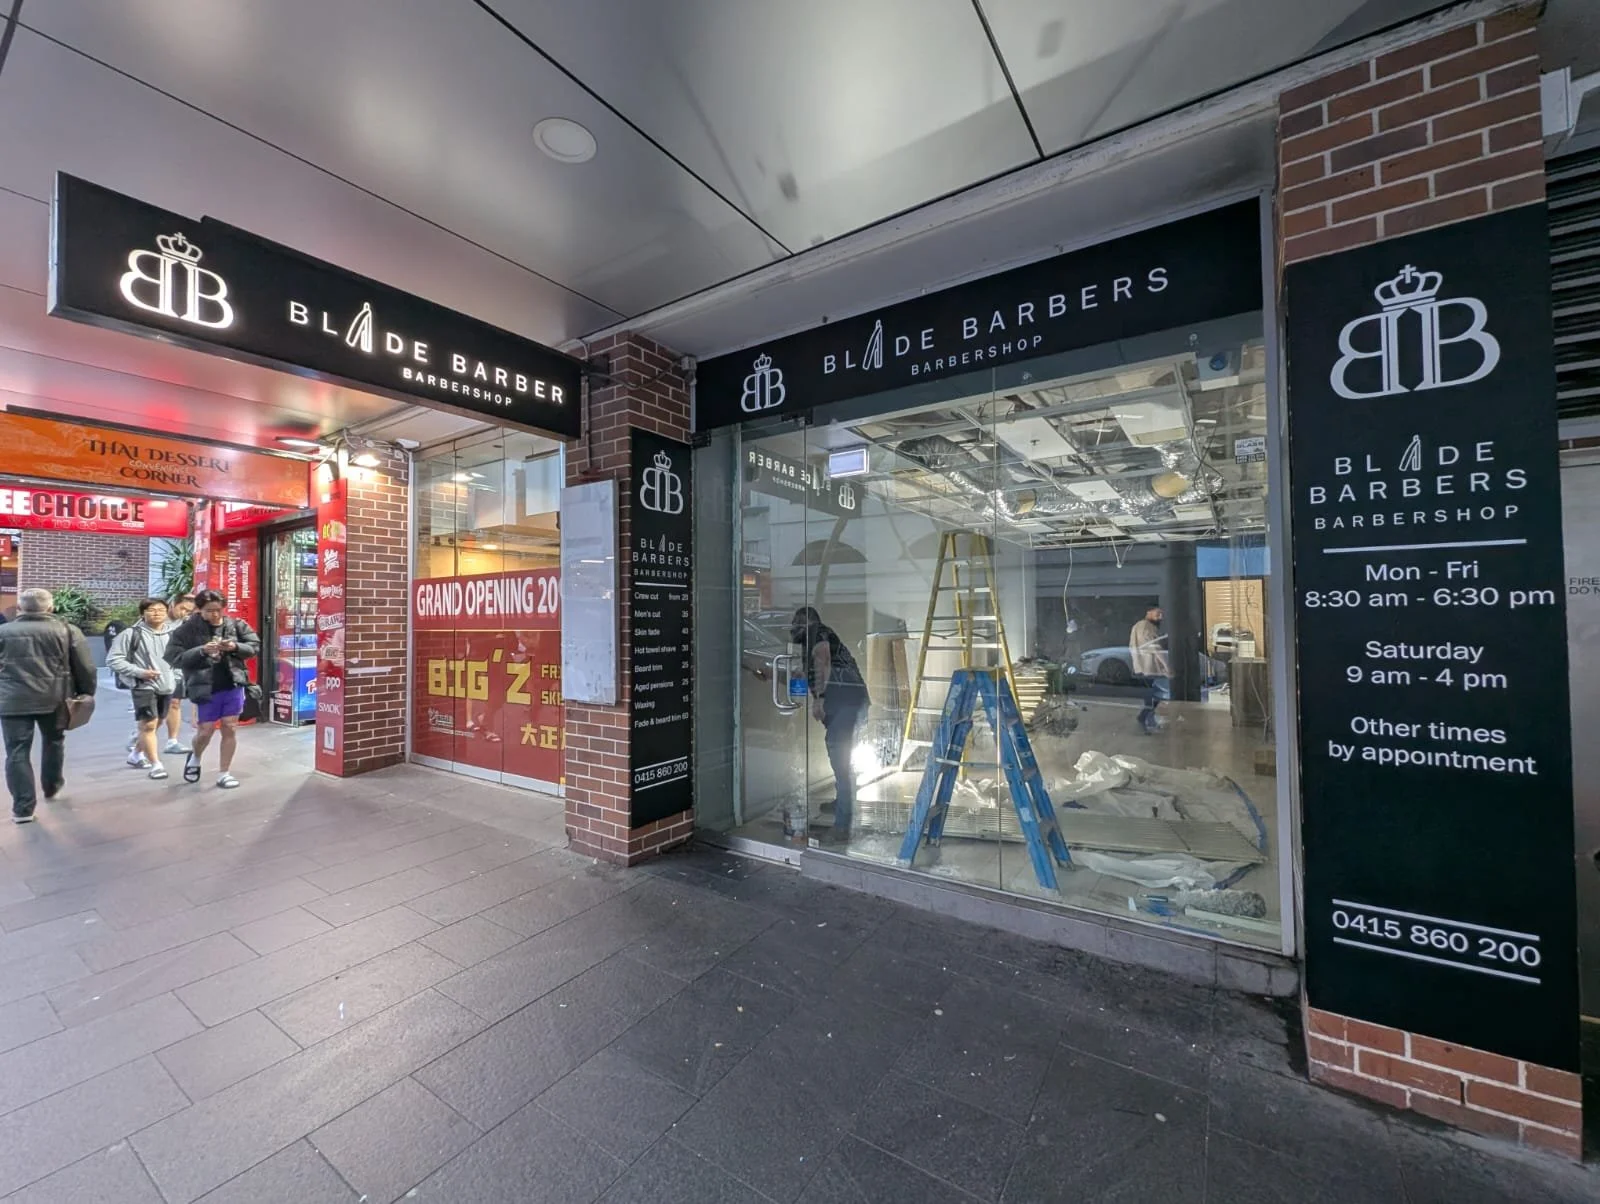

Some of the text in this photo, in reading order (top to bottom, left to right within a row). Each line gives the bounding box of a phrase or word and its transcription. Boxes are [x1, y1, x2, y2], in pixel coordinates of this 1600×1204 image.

[823, 267, 1169, 375] BLADE BARBERS
[289, 300, 564, 405] BLADE BARBER
[911, 335, 1043, 376] BARBERSHOP
[402, 367, 513, 407] BARBERSHOP
[84, 438, 231, 473] THAI DESSERT
[1335, 434, 1495, 476] BLADE
[120, 466, 202, 488] CORNER
[1309, 468, 1528, 505] BARBERS
[1314, 504, 1519, 530] BARBERSHOP
[640, 533, 683, 553] BLADE
[632, 552, 690, 567] BARBERS
[1365, 564, 1421, 582] Mon
[1446, 560, 1480, 580] Fri
[634, 568, 688, 579] BARBERSHOP
[1569, 576, 1600, 586] FIRE
[416, 575, 562, 617] GRAND OPENING 20
[1305, 590, 1361, 608] 8:30
[1369, 592, 1409, 607] am
[1433, 587, 1499, 606] 6:30
[1509, 589, 1556, 608] pm
[1569, 586, 1590, 595] DO
[635, 610, 651, 618] Men's
[1365, 641, 1484, 664] Saturday
[541, 664, 561, 679] FR
[635, 664, 651, 673] Beard
[1346, 666, 1363, 683] 9
[1371, 670, 1411, 685] am
[1435, 668, 1454, 686] 4
[1463, 672, 1508, 691] pm
[635, 683, 649, 692] Aged
[635, 701, 655, 710] Waxing
[635, 720, 649, 728] Fade
[656, 716, 671, 724] beard
[1350, 716, 1507, 744] Other times
[1328, 740, 1538, 775] by appointment
[634, 761, 688, 784] 0415 860 200
[1332, 910, 1542, 967] 0415 860 200
